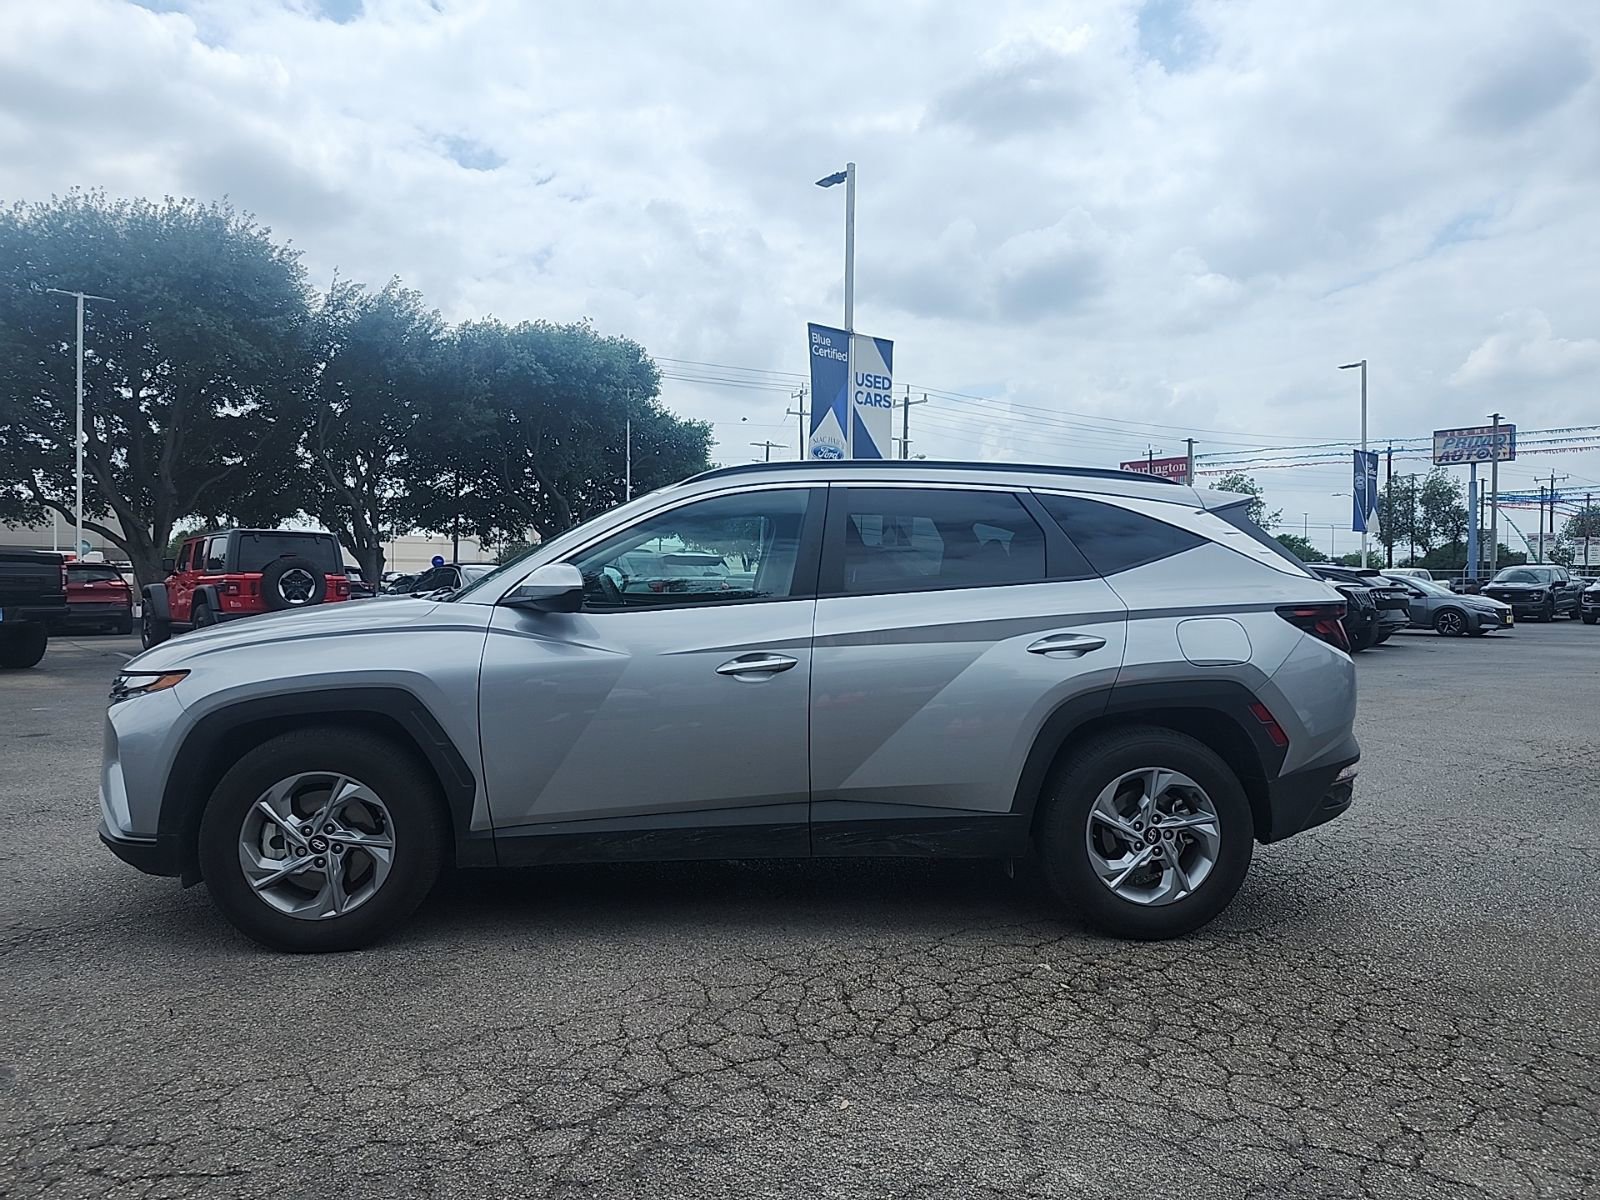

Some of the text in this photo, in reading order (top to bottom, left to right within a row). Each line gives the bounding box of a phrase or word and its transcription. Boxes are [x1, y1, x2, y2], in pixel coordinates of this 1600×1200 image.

[811, 332, 832, 346] Blue
[812, 345, 848, 362] Certified
[855, 372, 892, 390] USED
[854, 390, 892, 409] CARS
[818, 446, 840, 459] Ford
